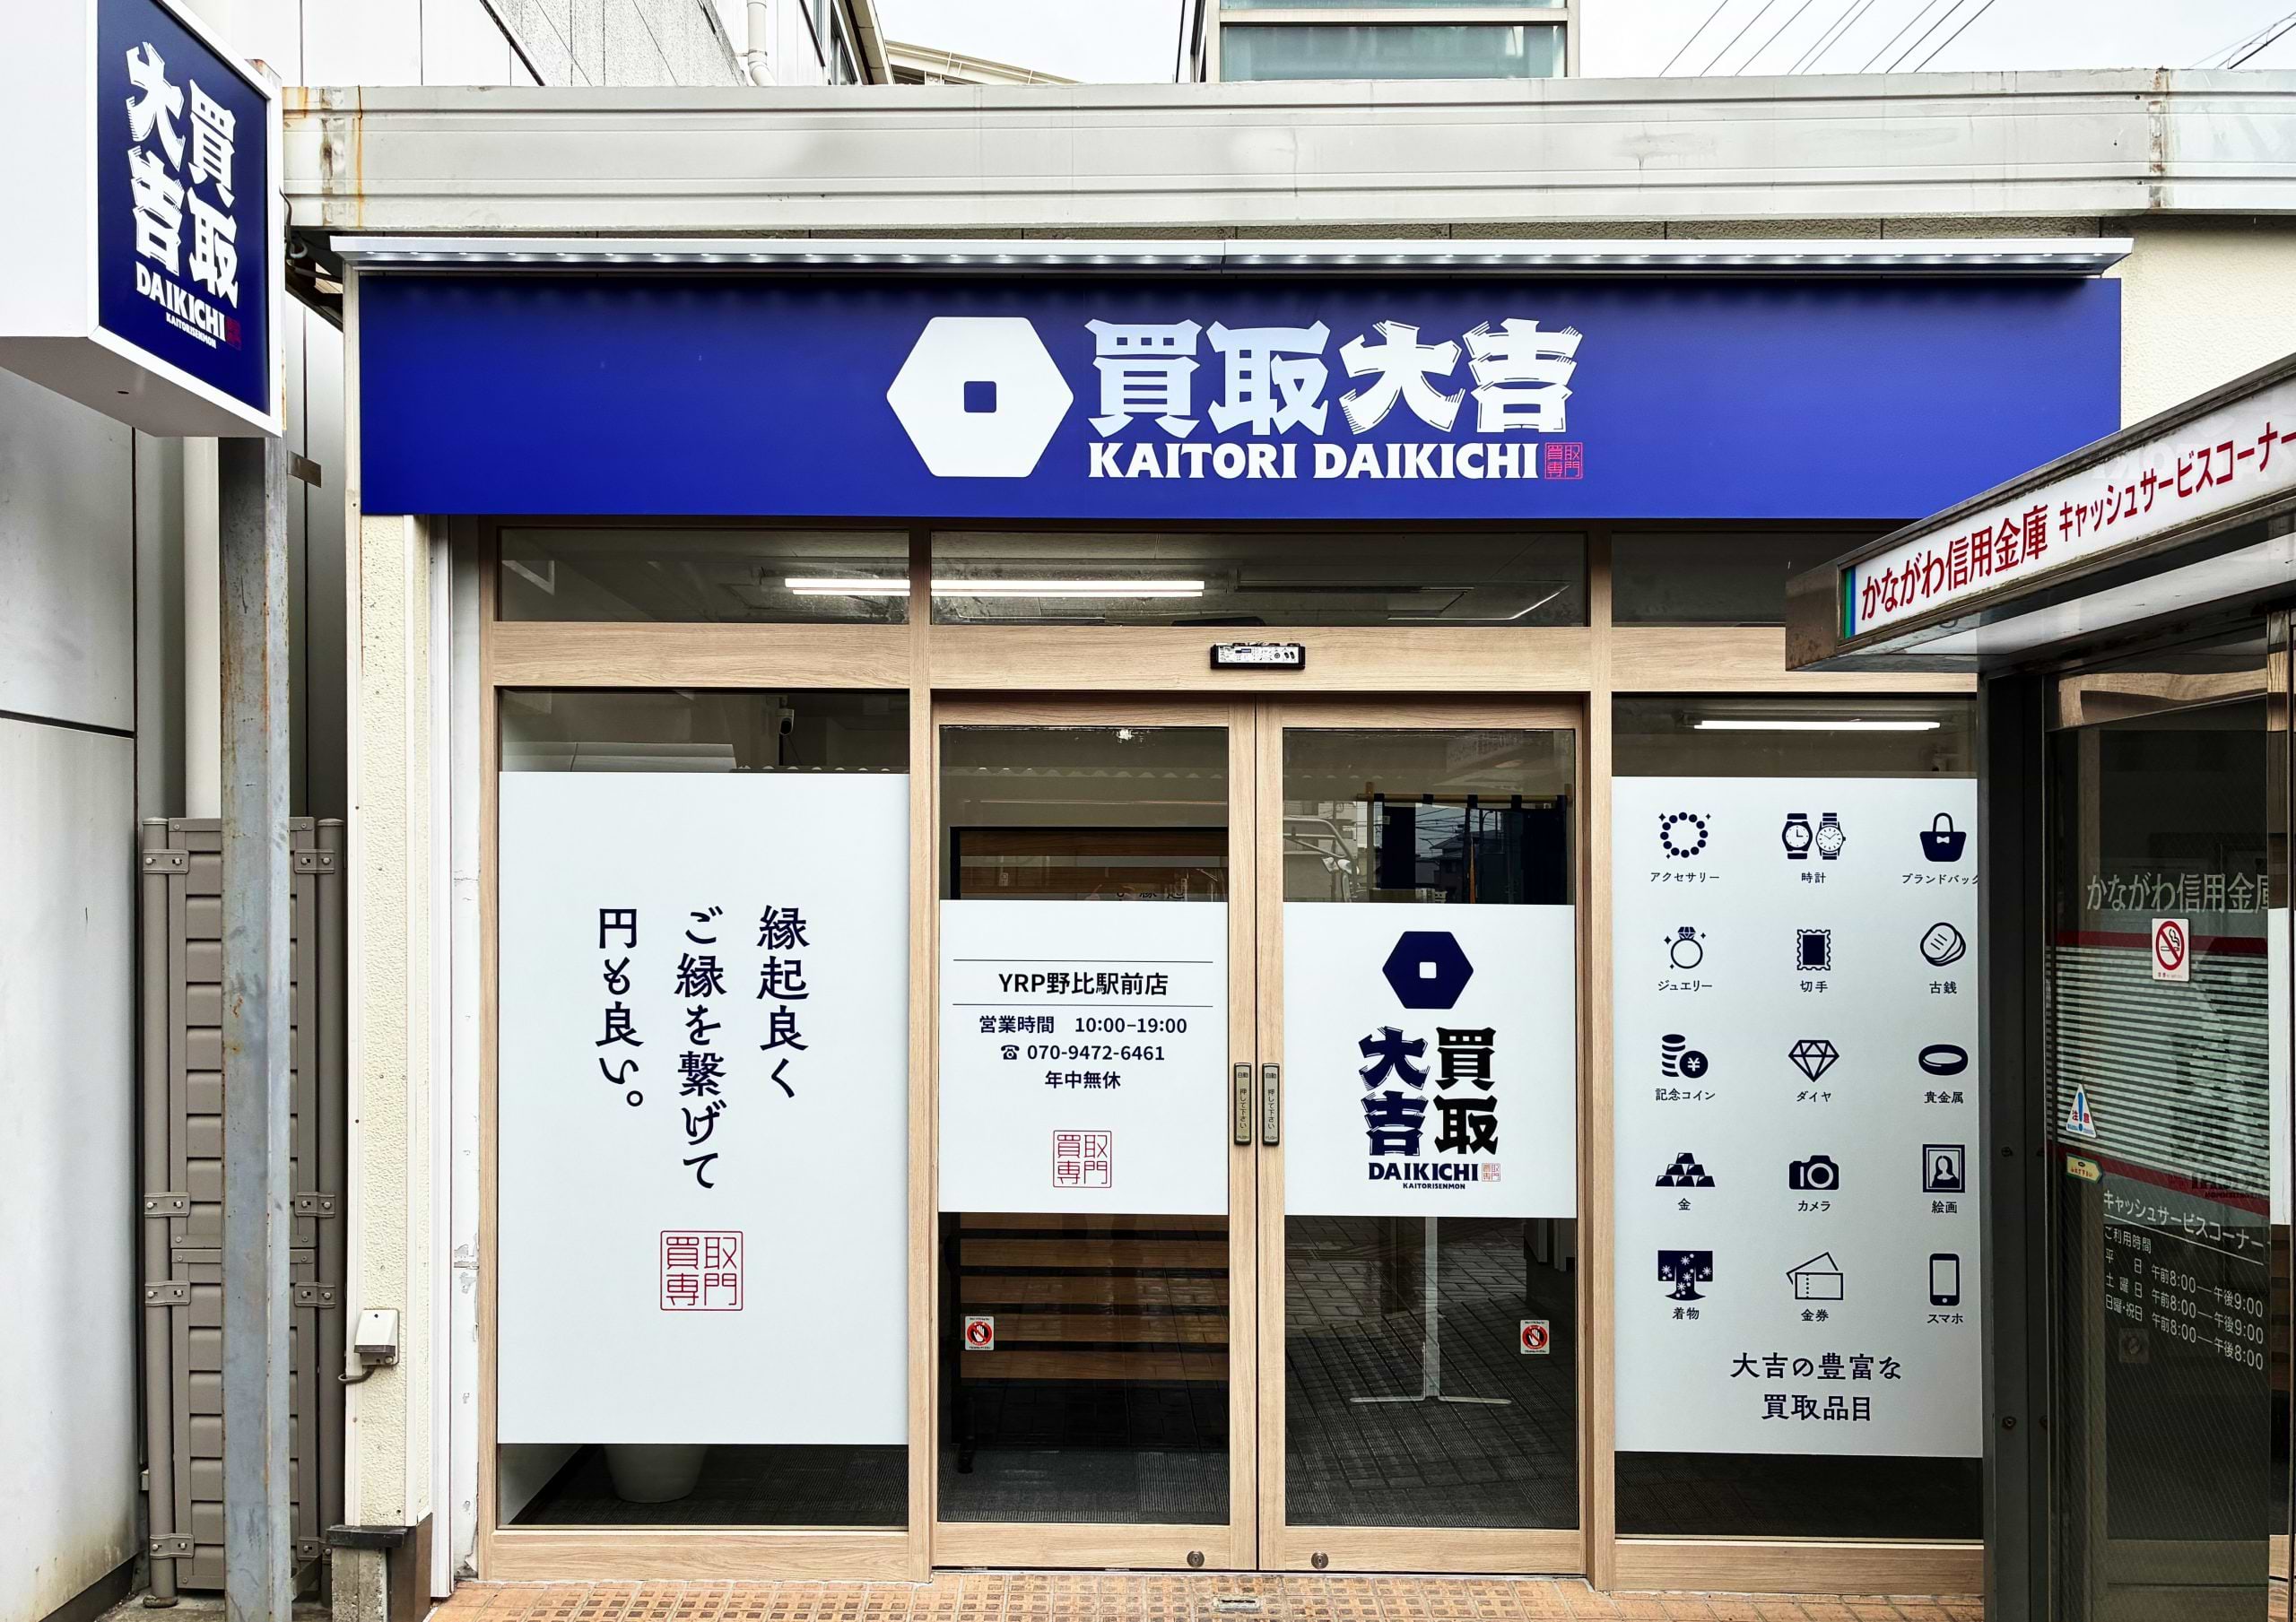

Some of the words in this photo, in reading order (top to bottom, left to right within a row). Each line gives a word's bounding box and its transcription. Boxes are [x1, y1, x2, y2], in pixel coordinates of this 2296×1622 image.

[126, 41, 186, 277] 大吉
[187, 79, 239, 309] 買取
[135, 261, 226, 342] DAIKICHI
[1084, 317, 1583, 438] 買取大吉
[1088, 442, 1298, 479] KAITORI
[1312, 442, 1539, 480] DAIKICHI
[1862, 504, 2048, 620] かながわ信用金庫
[2059, 421, 2296, 542] キャッシュサービスコーナー
[1650, 872, 1720, 883] アクセサリー
[1801, 872, 1827, 884] 時計
[998, 971, 1169, 996] YRP野比駅前店
[1657, 979, 1713, 993] ジュエリー
[1799, 980, 1829, 993] 切手
[1928, 980, 1958, 994] 古銭
[595, 907, 645, 1107] 円も良い。
[755, 904, 811, 1098] 縁起良く
[978, 1014, 1055, 1034] 営業時間
[674, 906, 727, 1190] ご縁を繋げて
[1027, 1045, 1165, 1061] 070-9472-6461
[1044, 1070, 1121, 1089] 年中無休
[1358, 1026, 1431, 1157] 大吉
[1432, 1027, 1499, 1155] 買取
[1655, 1088, 1716, 1102] 記念コイン
[1796, 1090, 1831, 1103] ダイヤ
[1924, 1090, 1964, 1105] 貴金属
[1368, 1162, 1479, 1182] DAIKICHI
[1677, 1197, 1692, 1211] 金
[1797, 1200, 1831, 1212] カメラ
[1931, 1200, 1958, 1214] 絵画
[2103, 1189, 2265, 1249] キャッシュサービスコーナー
[2104, 1226, 2152, 1254] ご利用時間
[1672, 1306, 1700, 1321] 着物
[1800, 1308, 1830, 1323] 金券
[1926, 1313, 1964, 1325] スマホ
[1730, 1351, 1902, 1381] 大吉の豊富な
[1761, 1393, 1872, 1422] 買取品目
